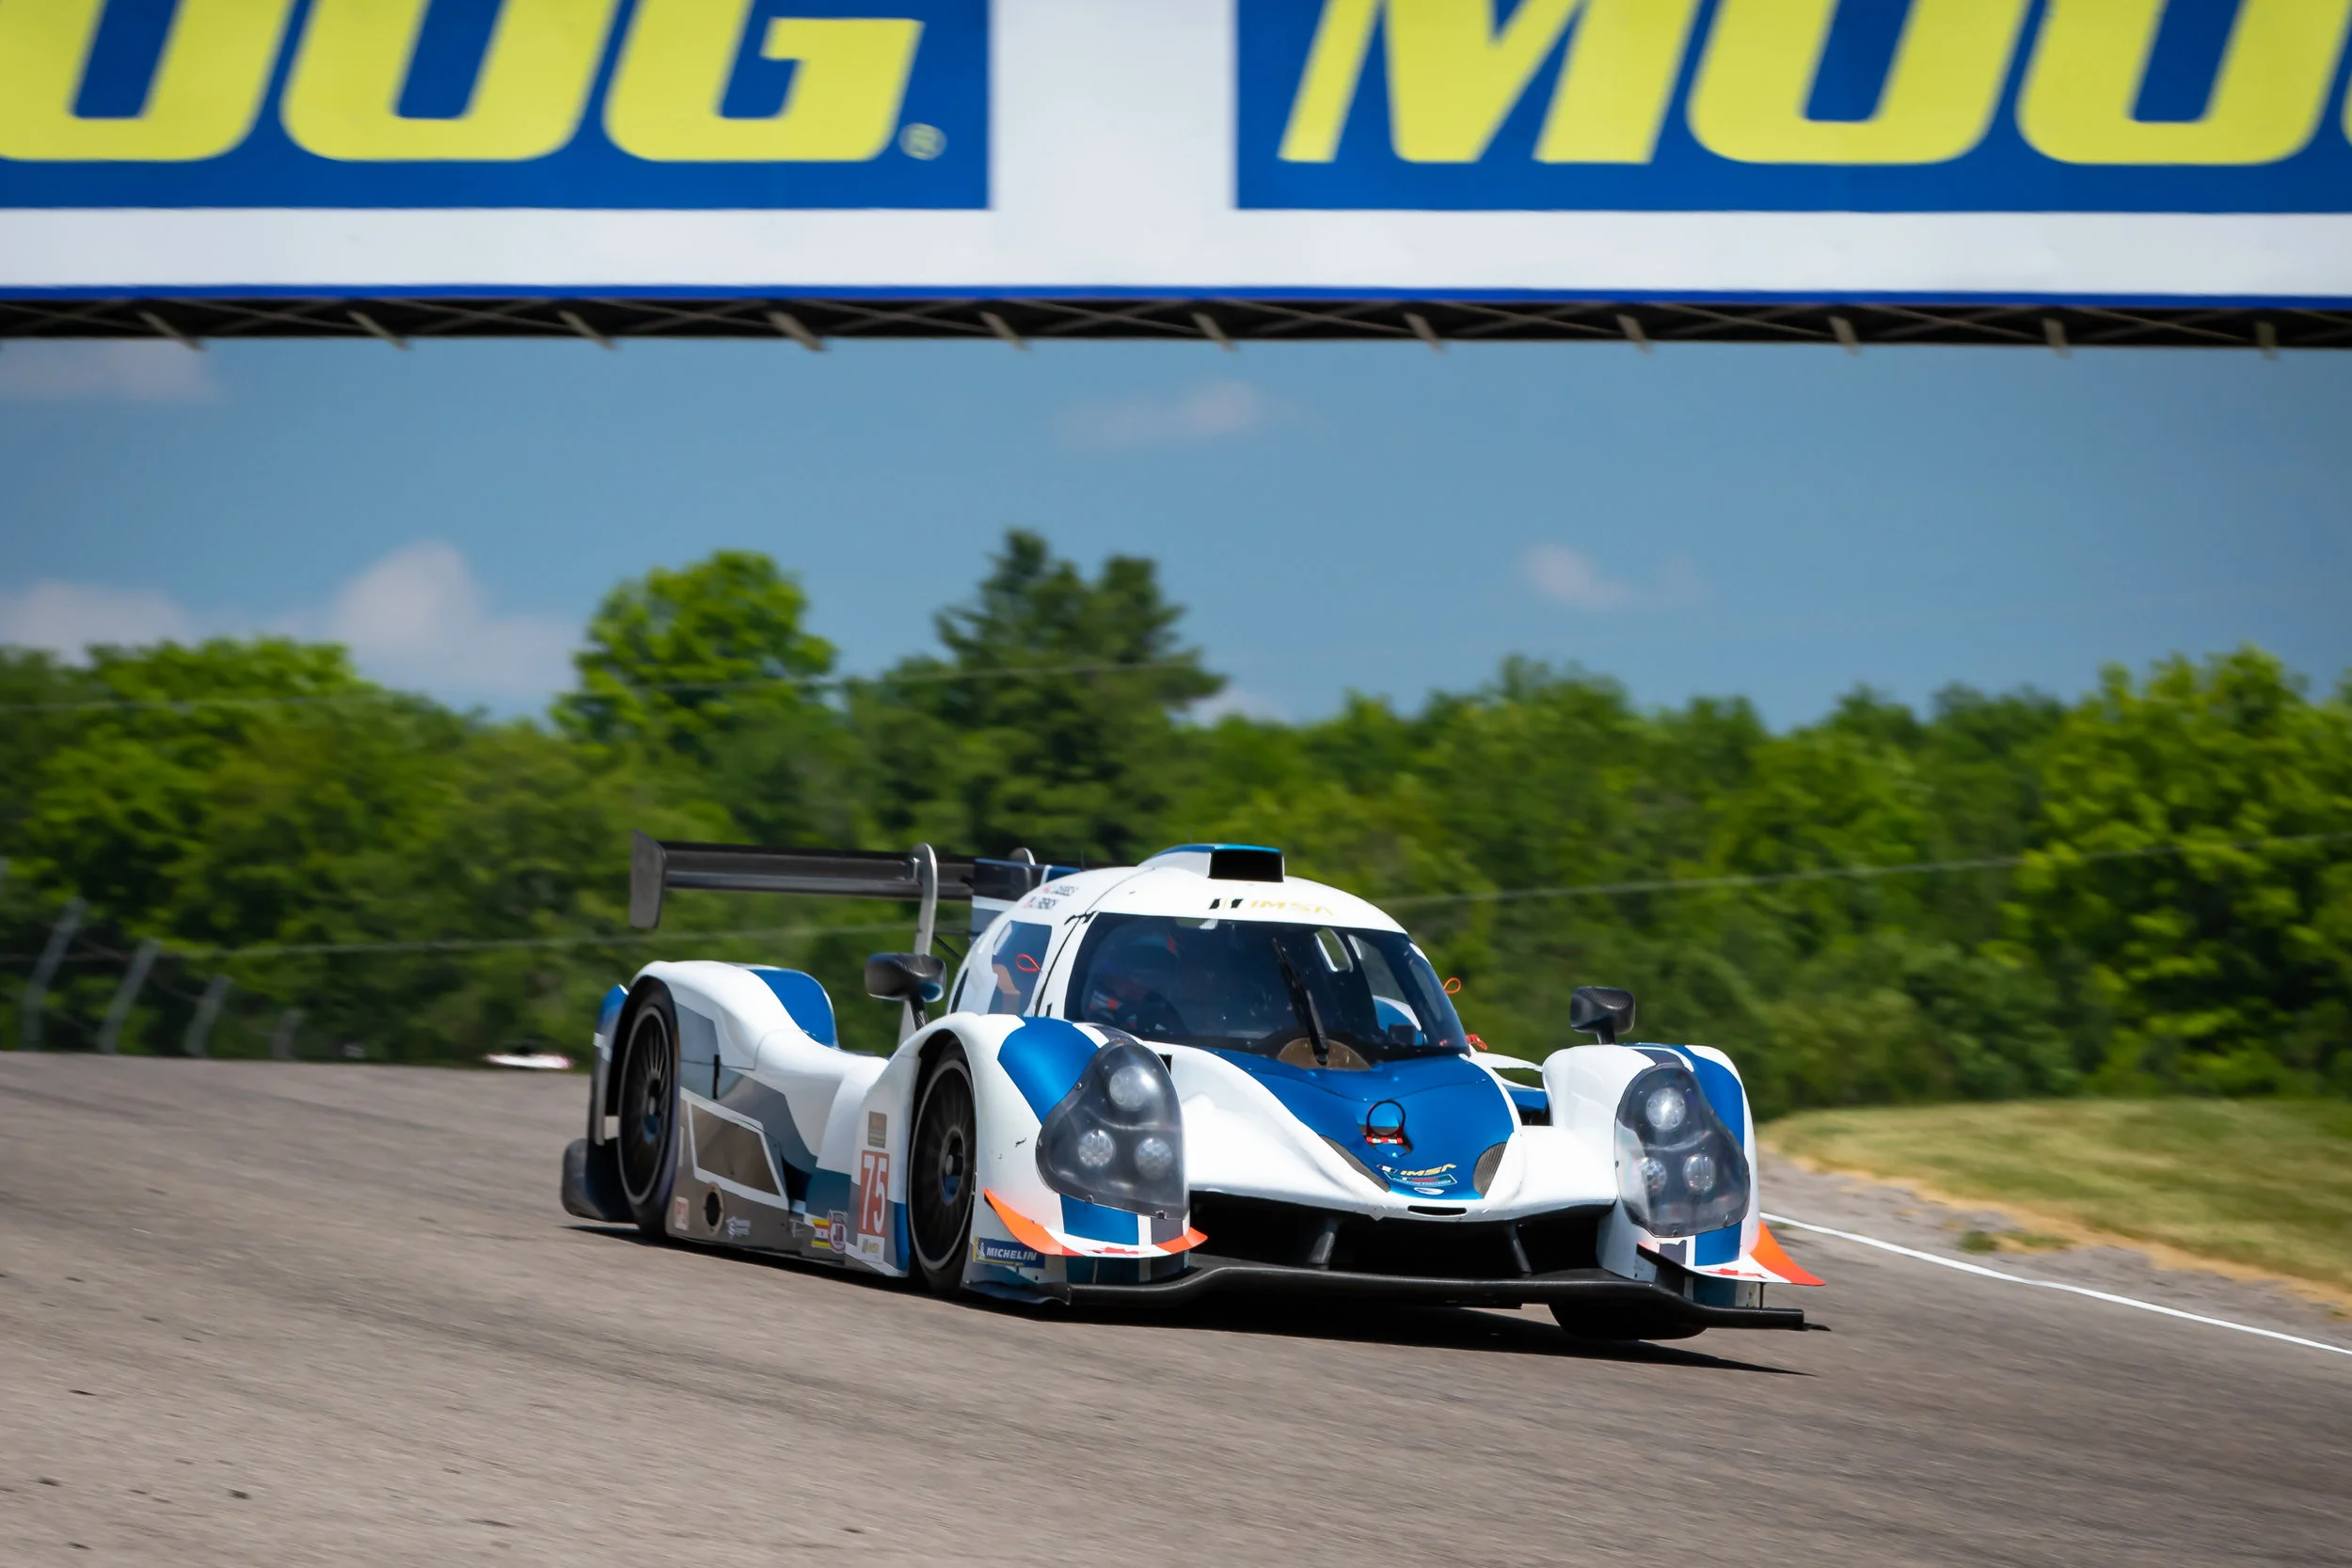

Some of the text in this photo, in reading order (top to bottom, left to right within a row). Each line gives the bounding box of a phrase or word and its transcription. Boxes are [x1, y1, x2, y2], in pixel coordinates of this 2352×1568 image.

[1277, 0, 2352, 166] MOO
[1249, 899, 1334, 916] IMSA
[1400, 1164, 1456, 1176] IMSA
[862, 1155, 887, 1234] 75
[986, 1247, 1038, 1260] MICHELIN
